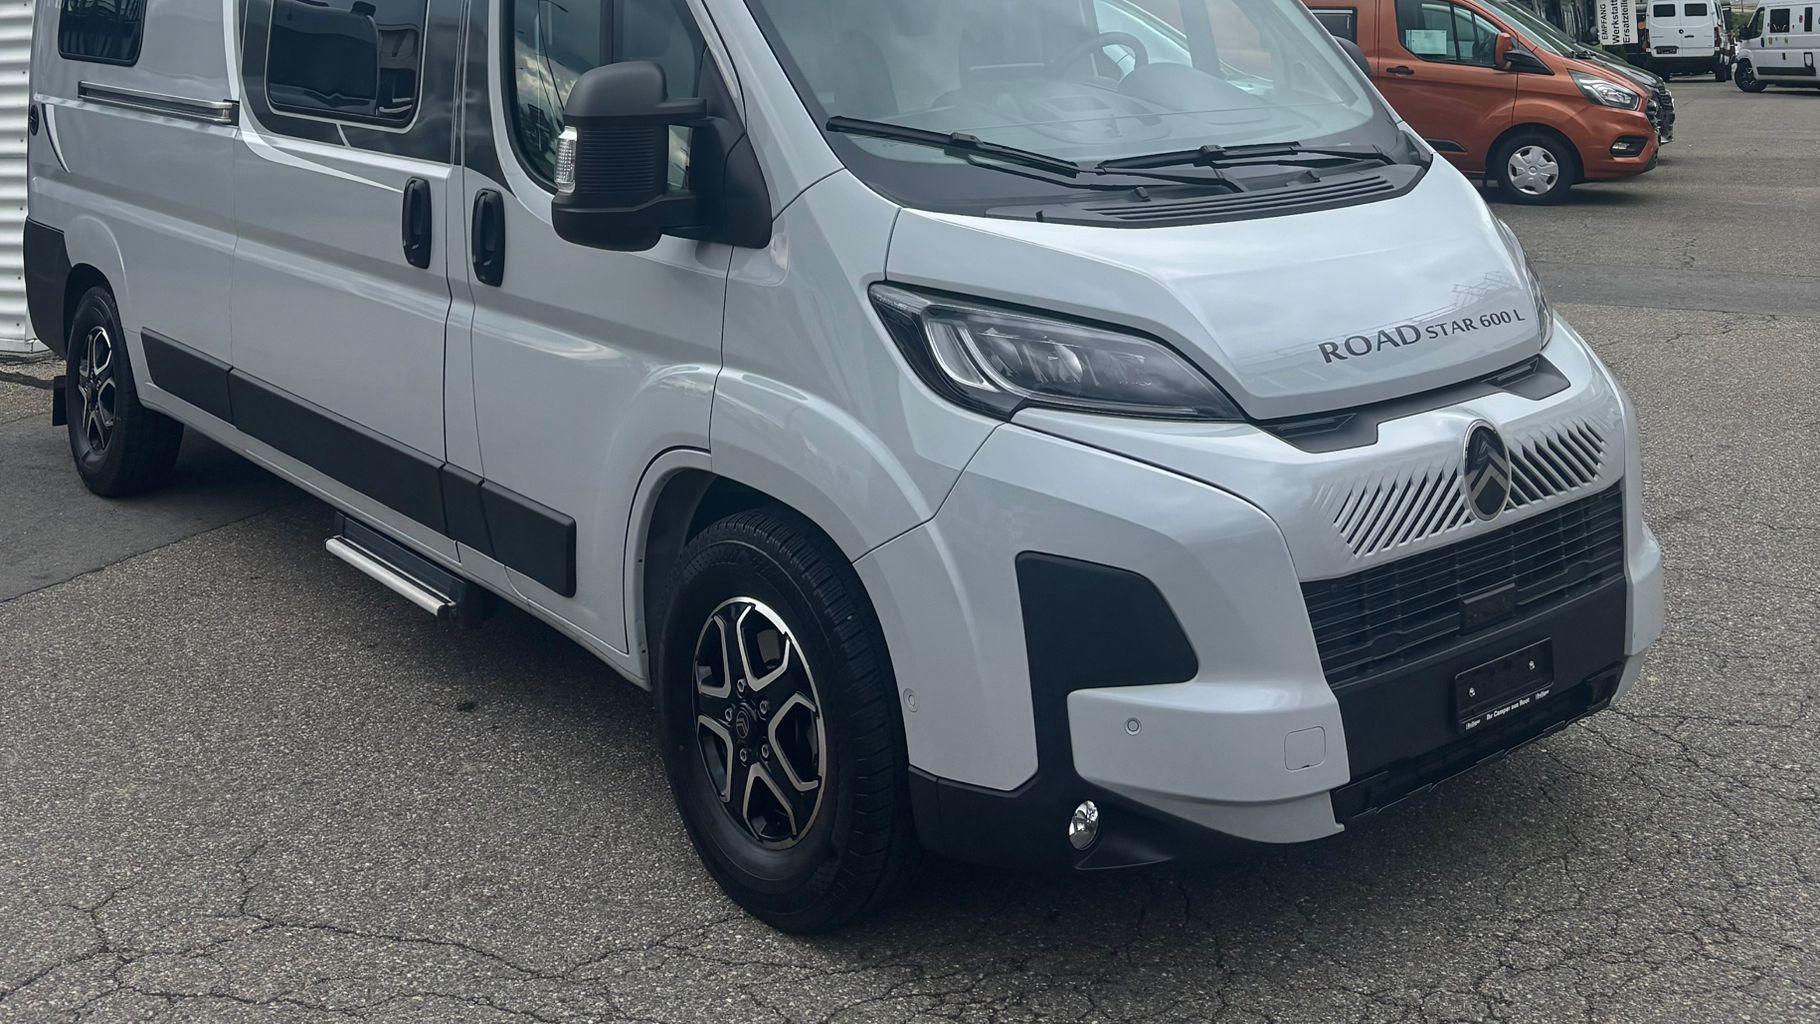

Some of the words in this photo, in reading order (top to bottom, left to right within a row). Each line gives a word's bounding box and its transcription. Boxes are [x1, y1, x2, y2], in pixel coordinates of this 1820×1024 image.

[1600, 3, 1608, 40] EMPFANG
[1611, 0, 1620, 44] Werkstatt
[1318, 324, 1422, 364] ROAD
[1425, 317, 1479, 340] STAR
[1479, 309, 1512, 328] 600
[1514, 309, 1526, 321] L
